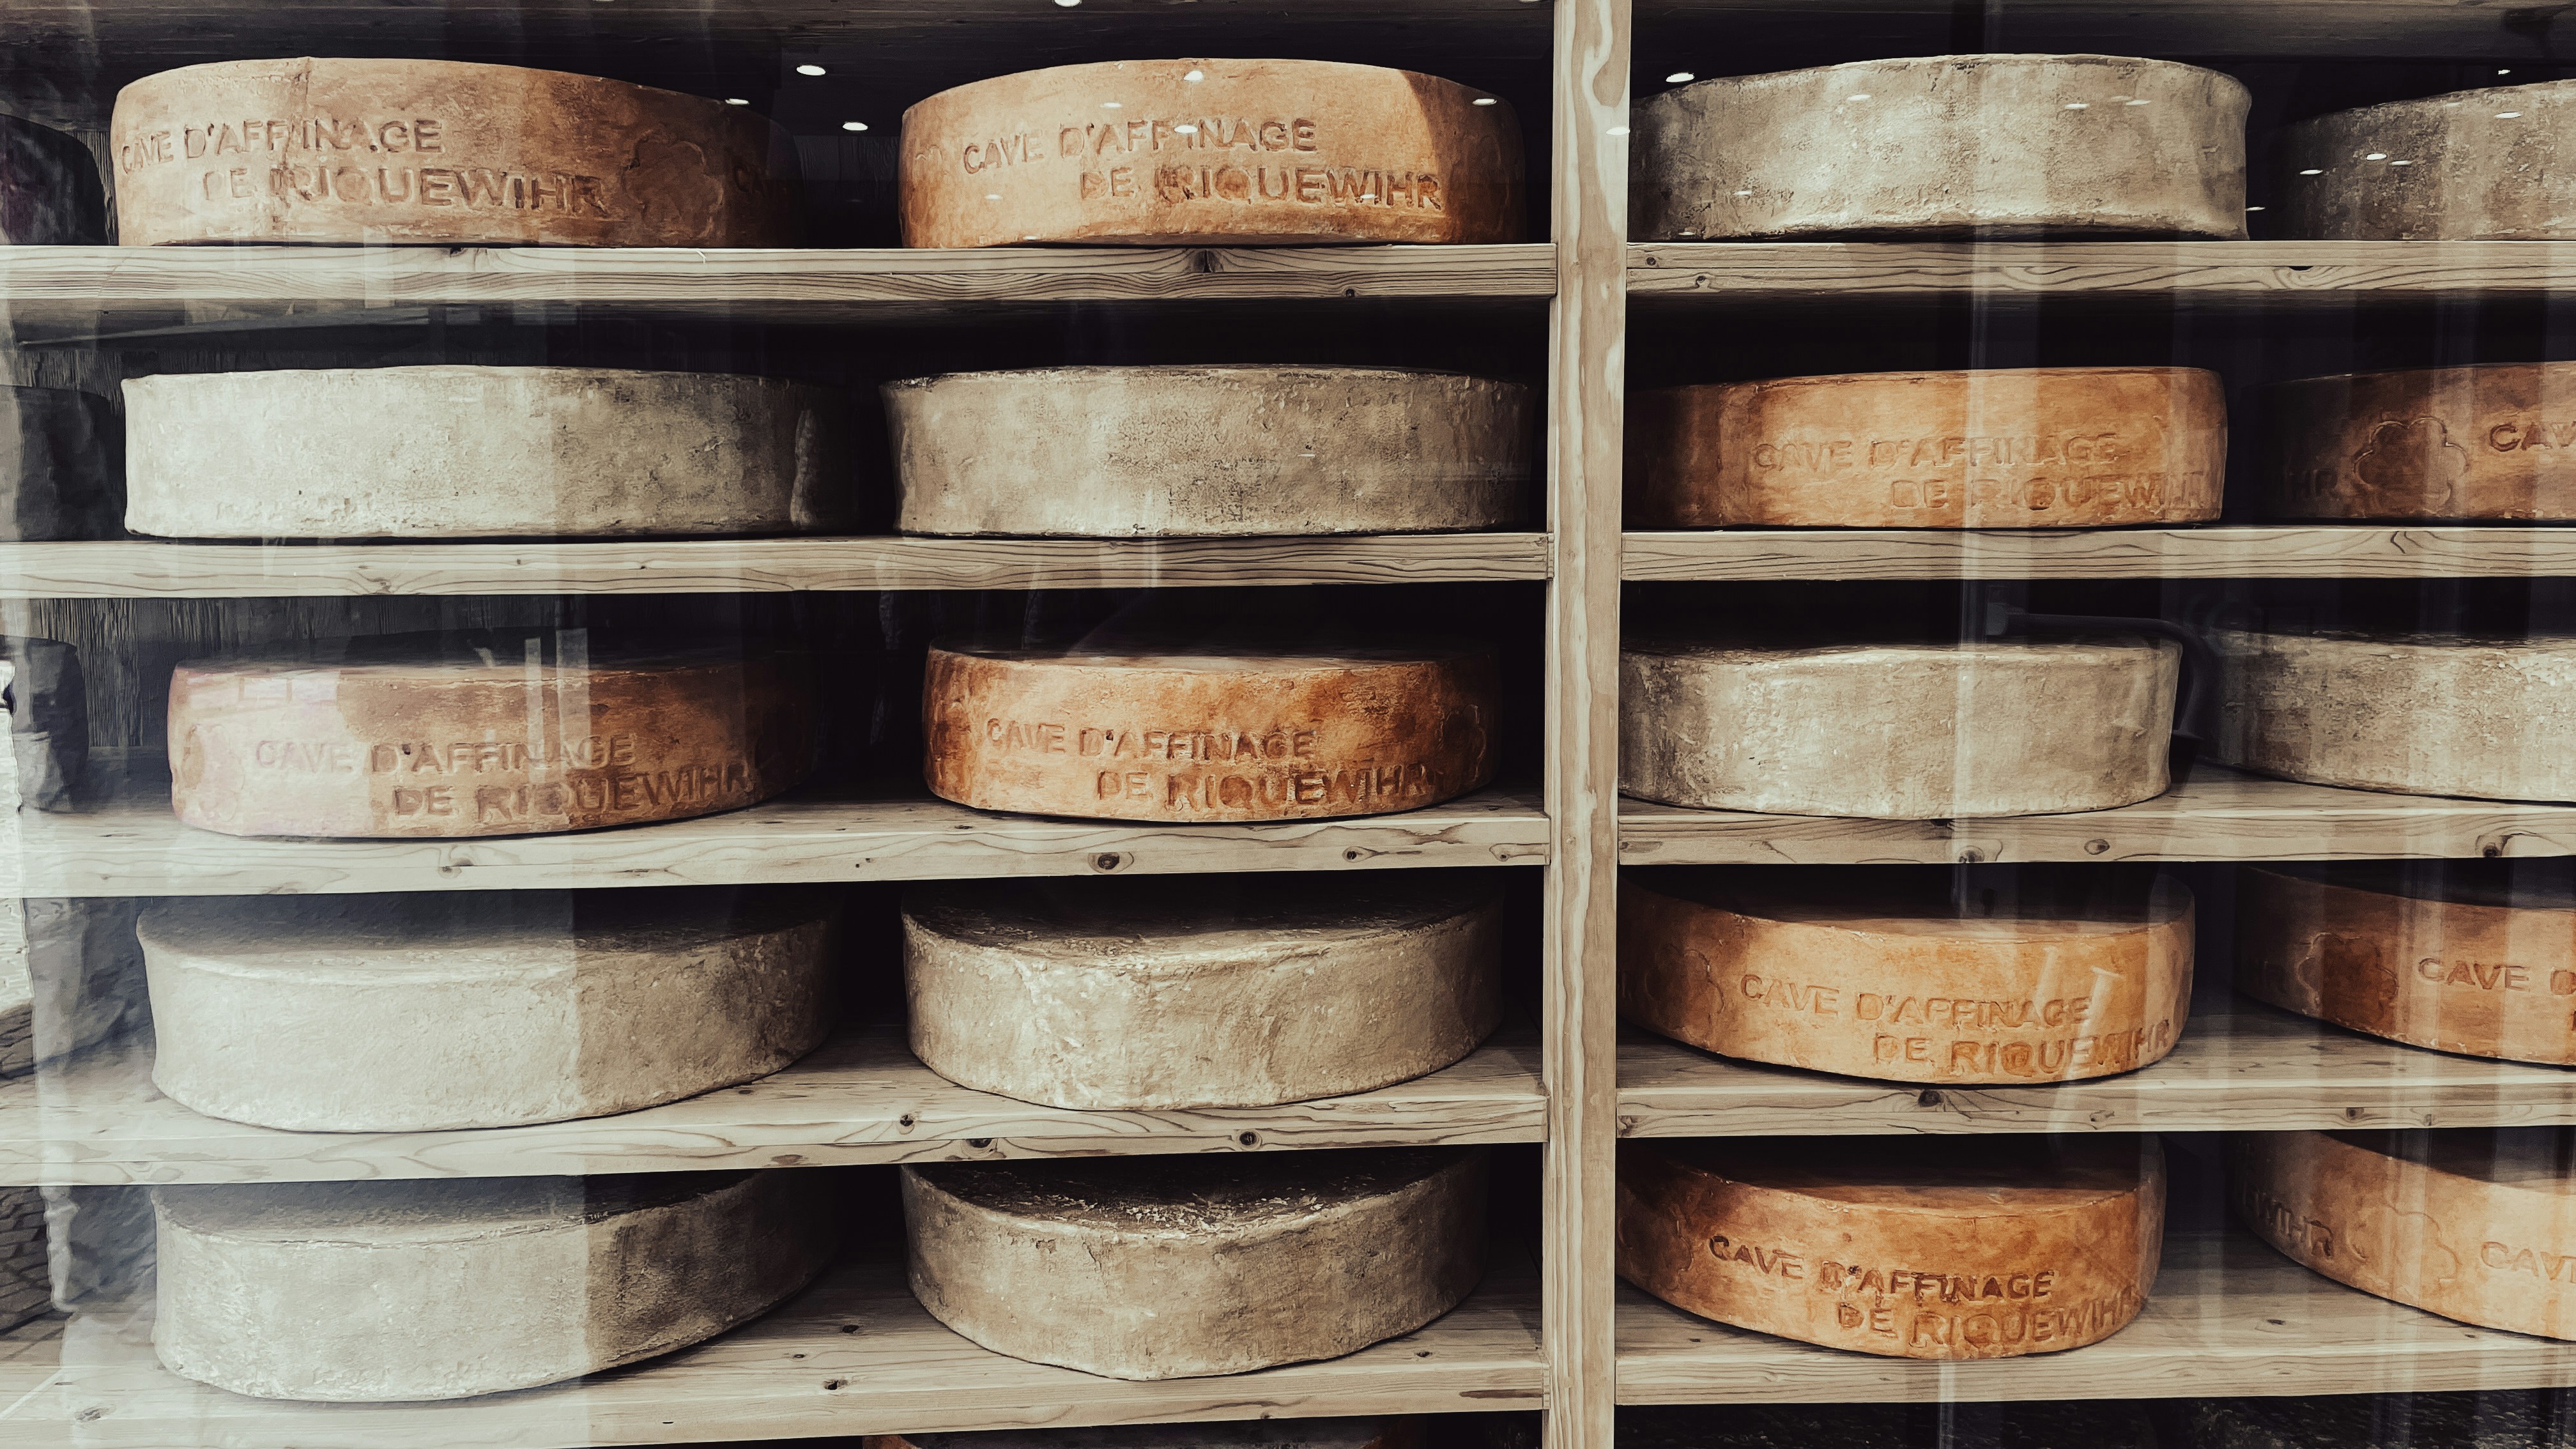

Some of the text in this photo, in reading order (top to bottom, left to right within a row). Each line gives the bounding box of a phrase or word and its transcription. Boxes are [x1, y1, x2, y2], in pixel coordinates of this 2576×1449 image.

[121, 118, 443, 174] CAVE D'AFFINAGE
[963, 116, 1317, 174] CAVE D'AFFINAGE
[202, 167, 253, 201] DE
[1081, 165, 1442, 211] DE RIQUEWIHR
[1753, 433, 2117, 474] CAVE D'AFFINAGE
[1891, 478, 1949, 509] DE
[254, 734, 638, 776] CAVE D'AFFINAGE
[986, 717, 1317, 765] CAVE D'AFFINAGE
[392, 786, 454, 816] DE
[1096, 770, 1151, 802] DE
[2418, 958, 2530, 992] CAVE
[1740, 974, 2090, 1030] CAVE D'AFFINAGE
[1873, 1032, 1933, 1064] DE
[1708, 1235, 2055, 1304] CAVE D'AFFINAGE
[2481, 1241, 2576, 1284] CAV
[1837, 1302, 1898, 1337] DE
